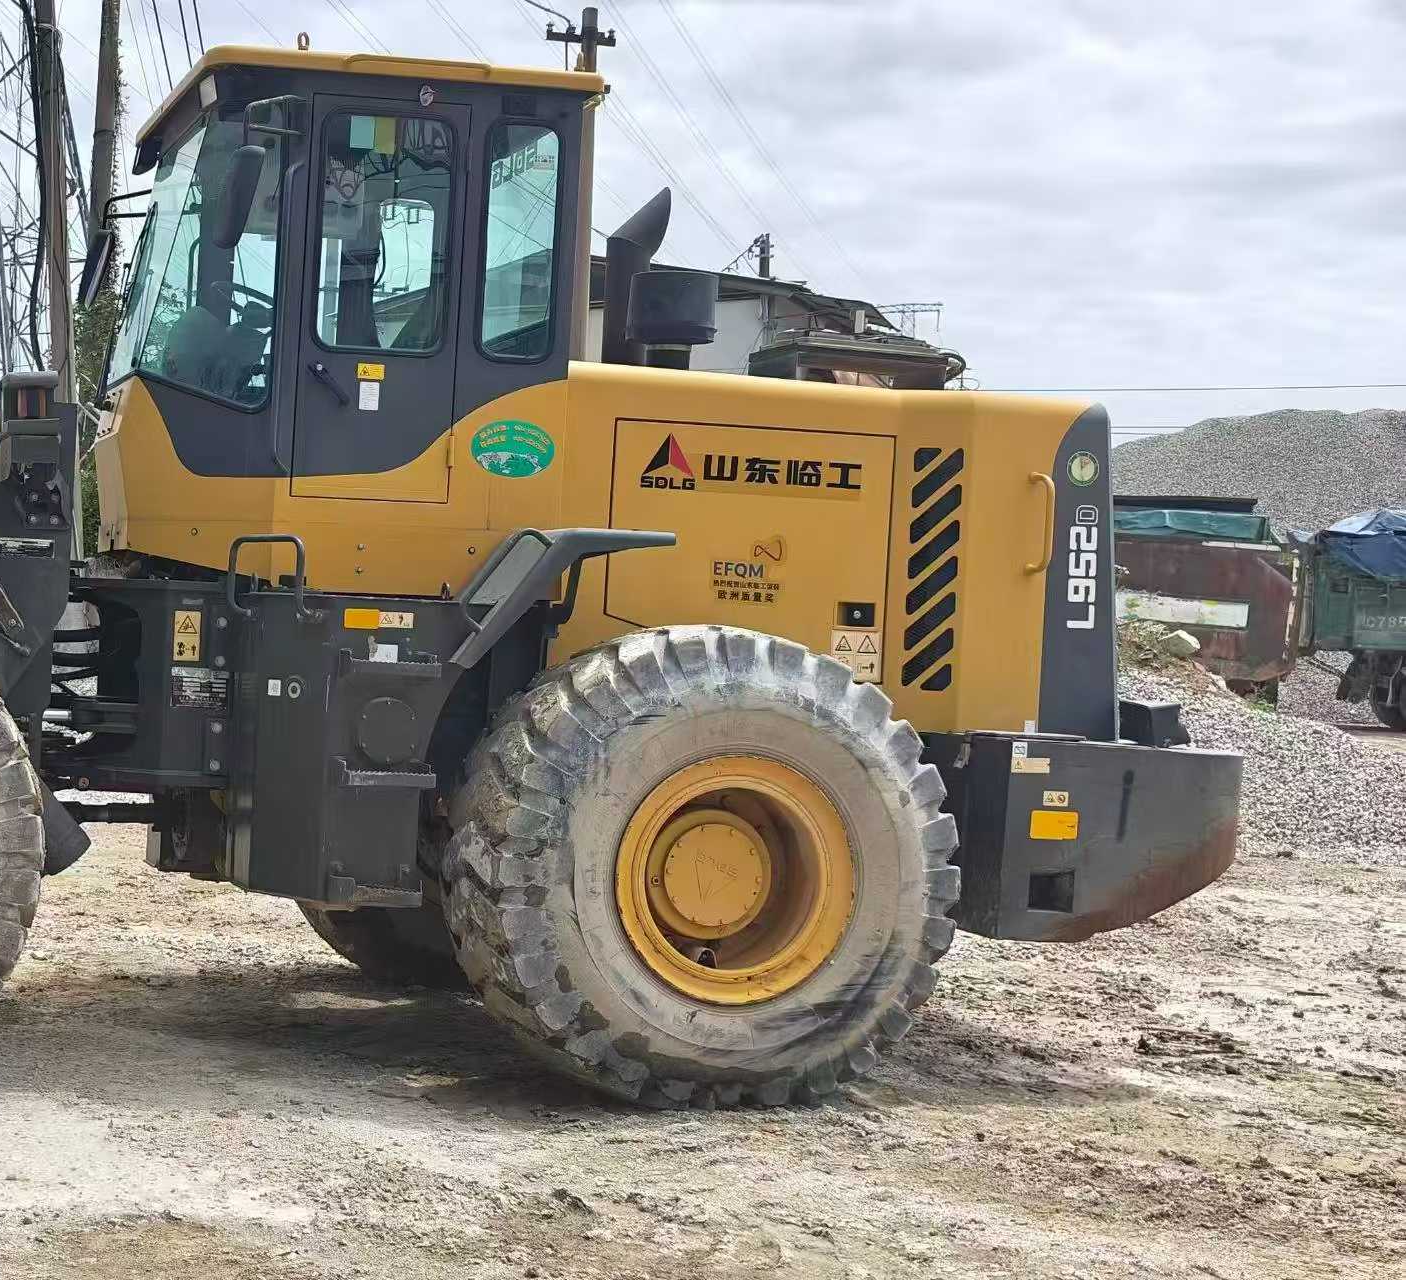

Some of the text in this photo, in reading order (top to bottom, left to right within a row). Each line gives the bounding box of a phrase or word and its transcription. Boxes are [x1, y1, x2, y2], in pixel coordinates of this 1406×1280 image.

[703, 454, 863, 490] 山东临工
[640, 475, 696, 490] SDLG
[713, 562, 764, 578] EFQM
[1066, 505, 1099, 629] L952D
[717, 590, 775, 603] 欧洲质量奖
